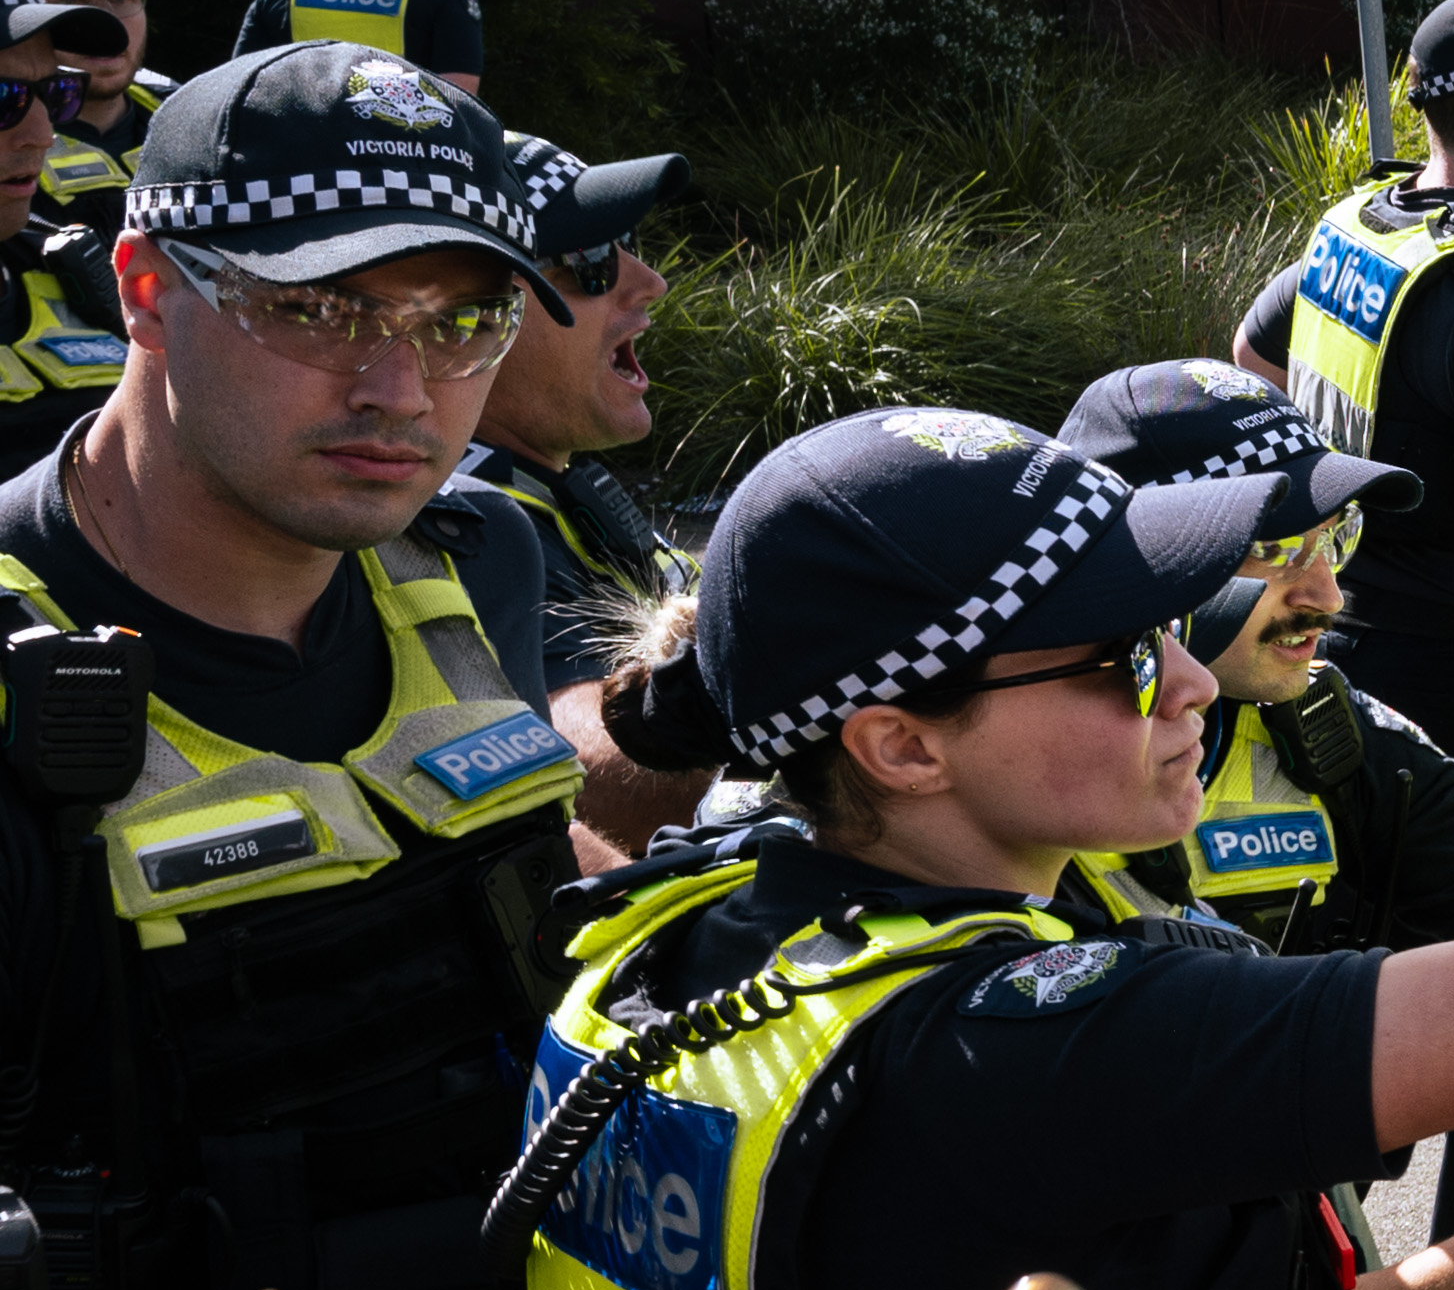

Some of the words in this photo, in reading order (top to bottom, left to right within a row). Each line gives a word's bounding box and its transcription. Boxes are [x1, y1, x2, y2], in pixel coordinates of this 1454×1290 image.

[345, 139, 426, 159] VICTORIA
[430, 144, 475, 171] POLICE
[1302, 229, 1386, 325] Police
[1231, 407, 1282, 431] VICTORIA
[1011, 442, 1060, 499] VICTORIA
[54, 666, 122, 676] MOTOROLA
[432, 724, 558, 785] Police
[203, 839, 260, 867] 42388
[1212, 826, 1319, 860] Police
[527, 1069, 701, 1277] Plice
